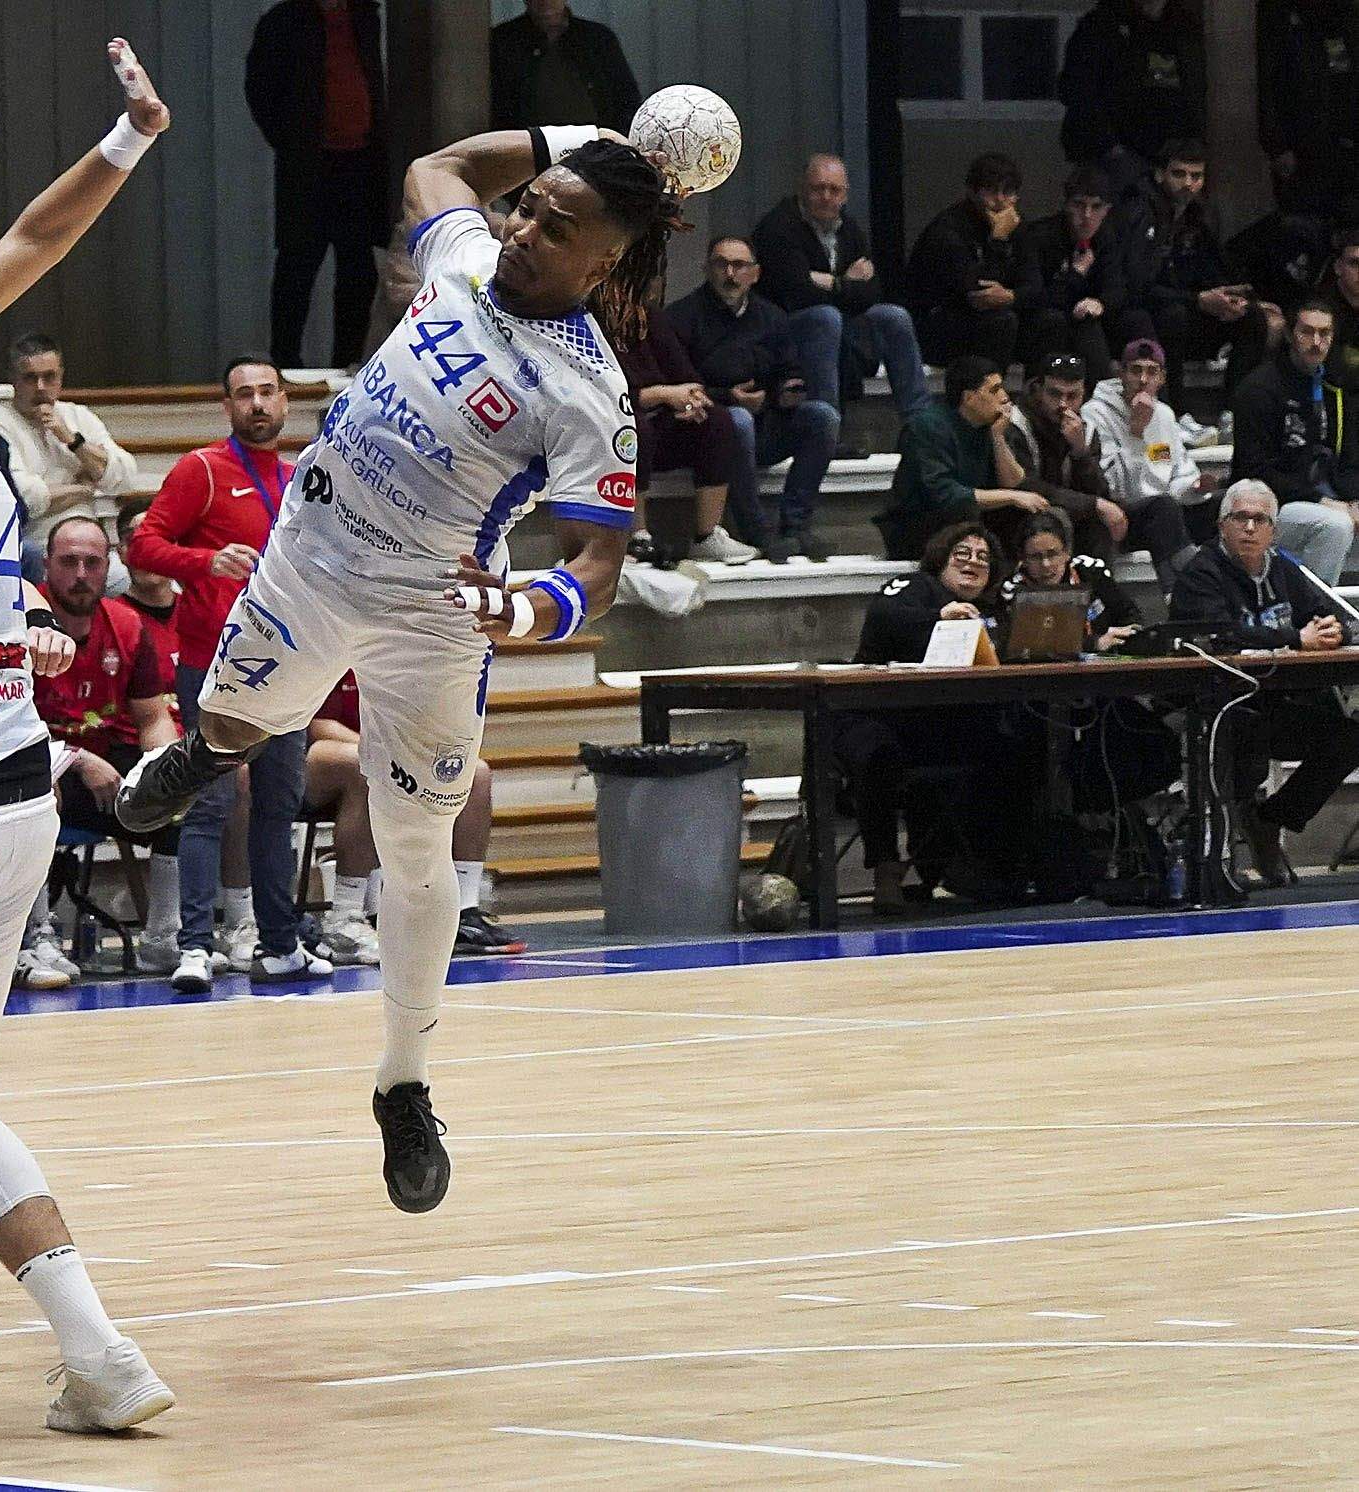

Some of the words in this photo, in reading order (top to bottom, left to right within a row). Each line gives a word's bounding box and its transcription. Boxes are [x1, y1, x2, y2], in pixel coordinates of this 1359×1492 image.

[408, 320, 488, 397] 44
[332, 432, 353, 464] DE
[351, 457, 428, 520] GALICIA
[341, 415, 396, 476] XUNTA
